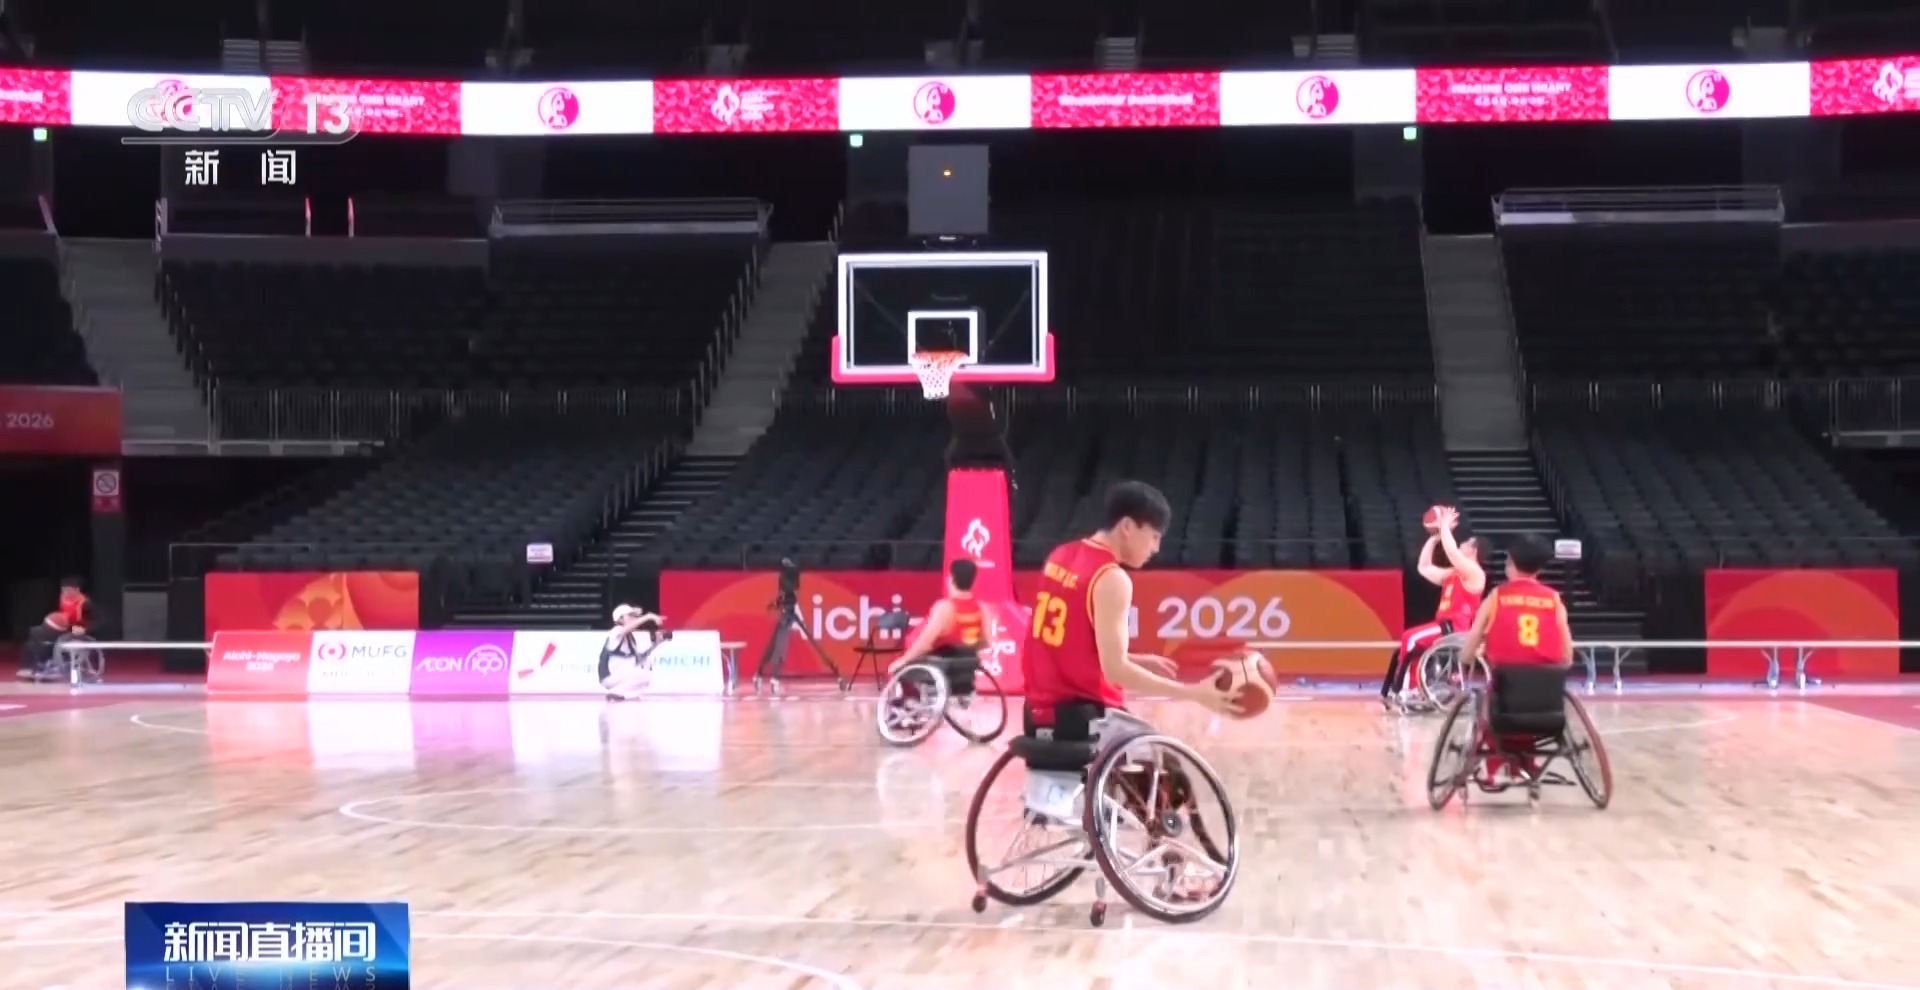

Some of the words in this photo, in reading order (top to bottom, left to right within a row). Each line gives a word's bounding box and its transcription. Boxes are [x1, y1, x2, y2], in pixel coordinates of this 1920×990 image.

[6, 412, 55, 429] 2026
[1032, 591, 1067, 647] 13
[1156, 596, 1290, 639] 2026
[1518, 614, 1539, 646] 8
[351, 645, 407, 658] MUFG
